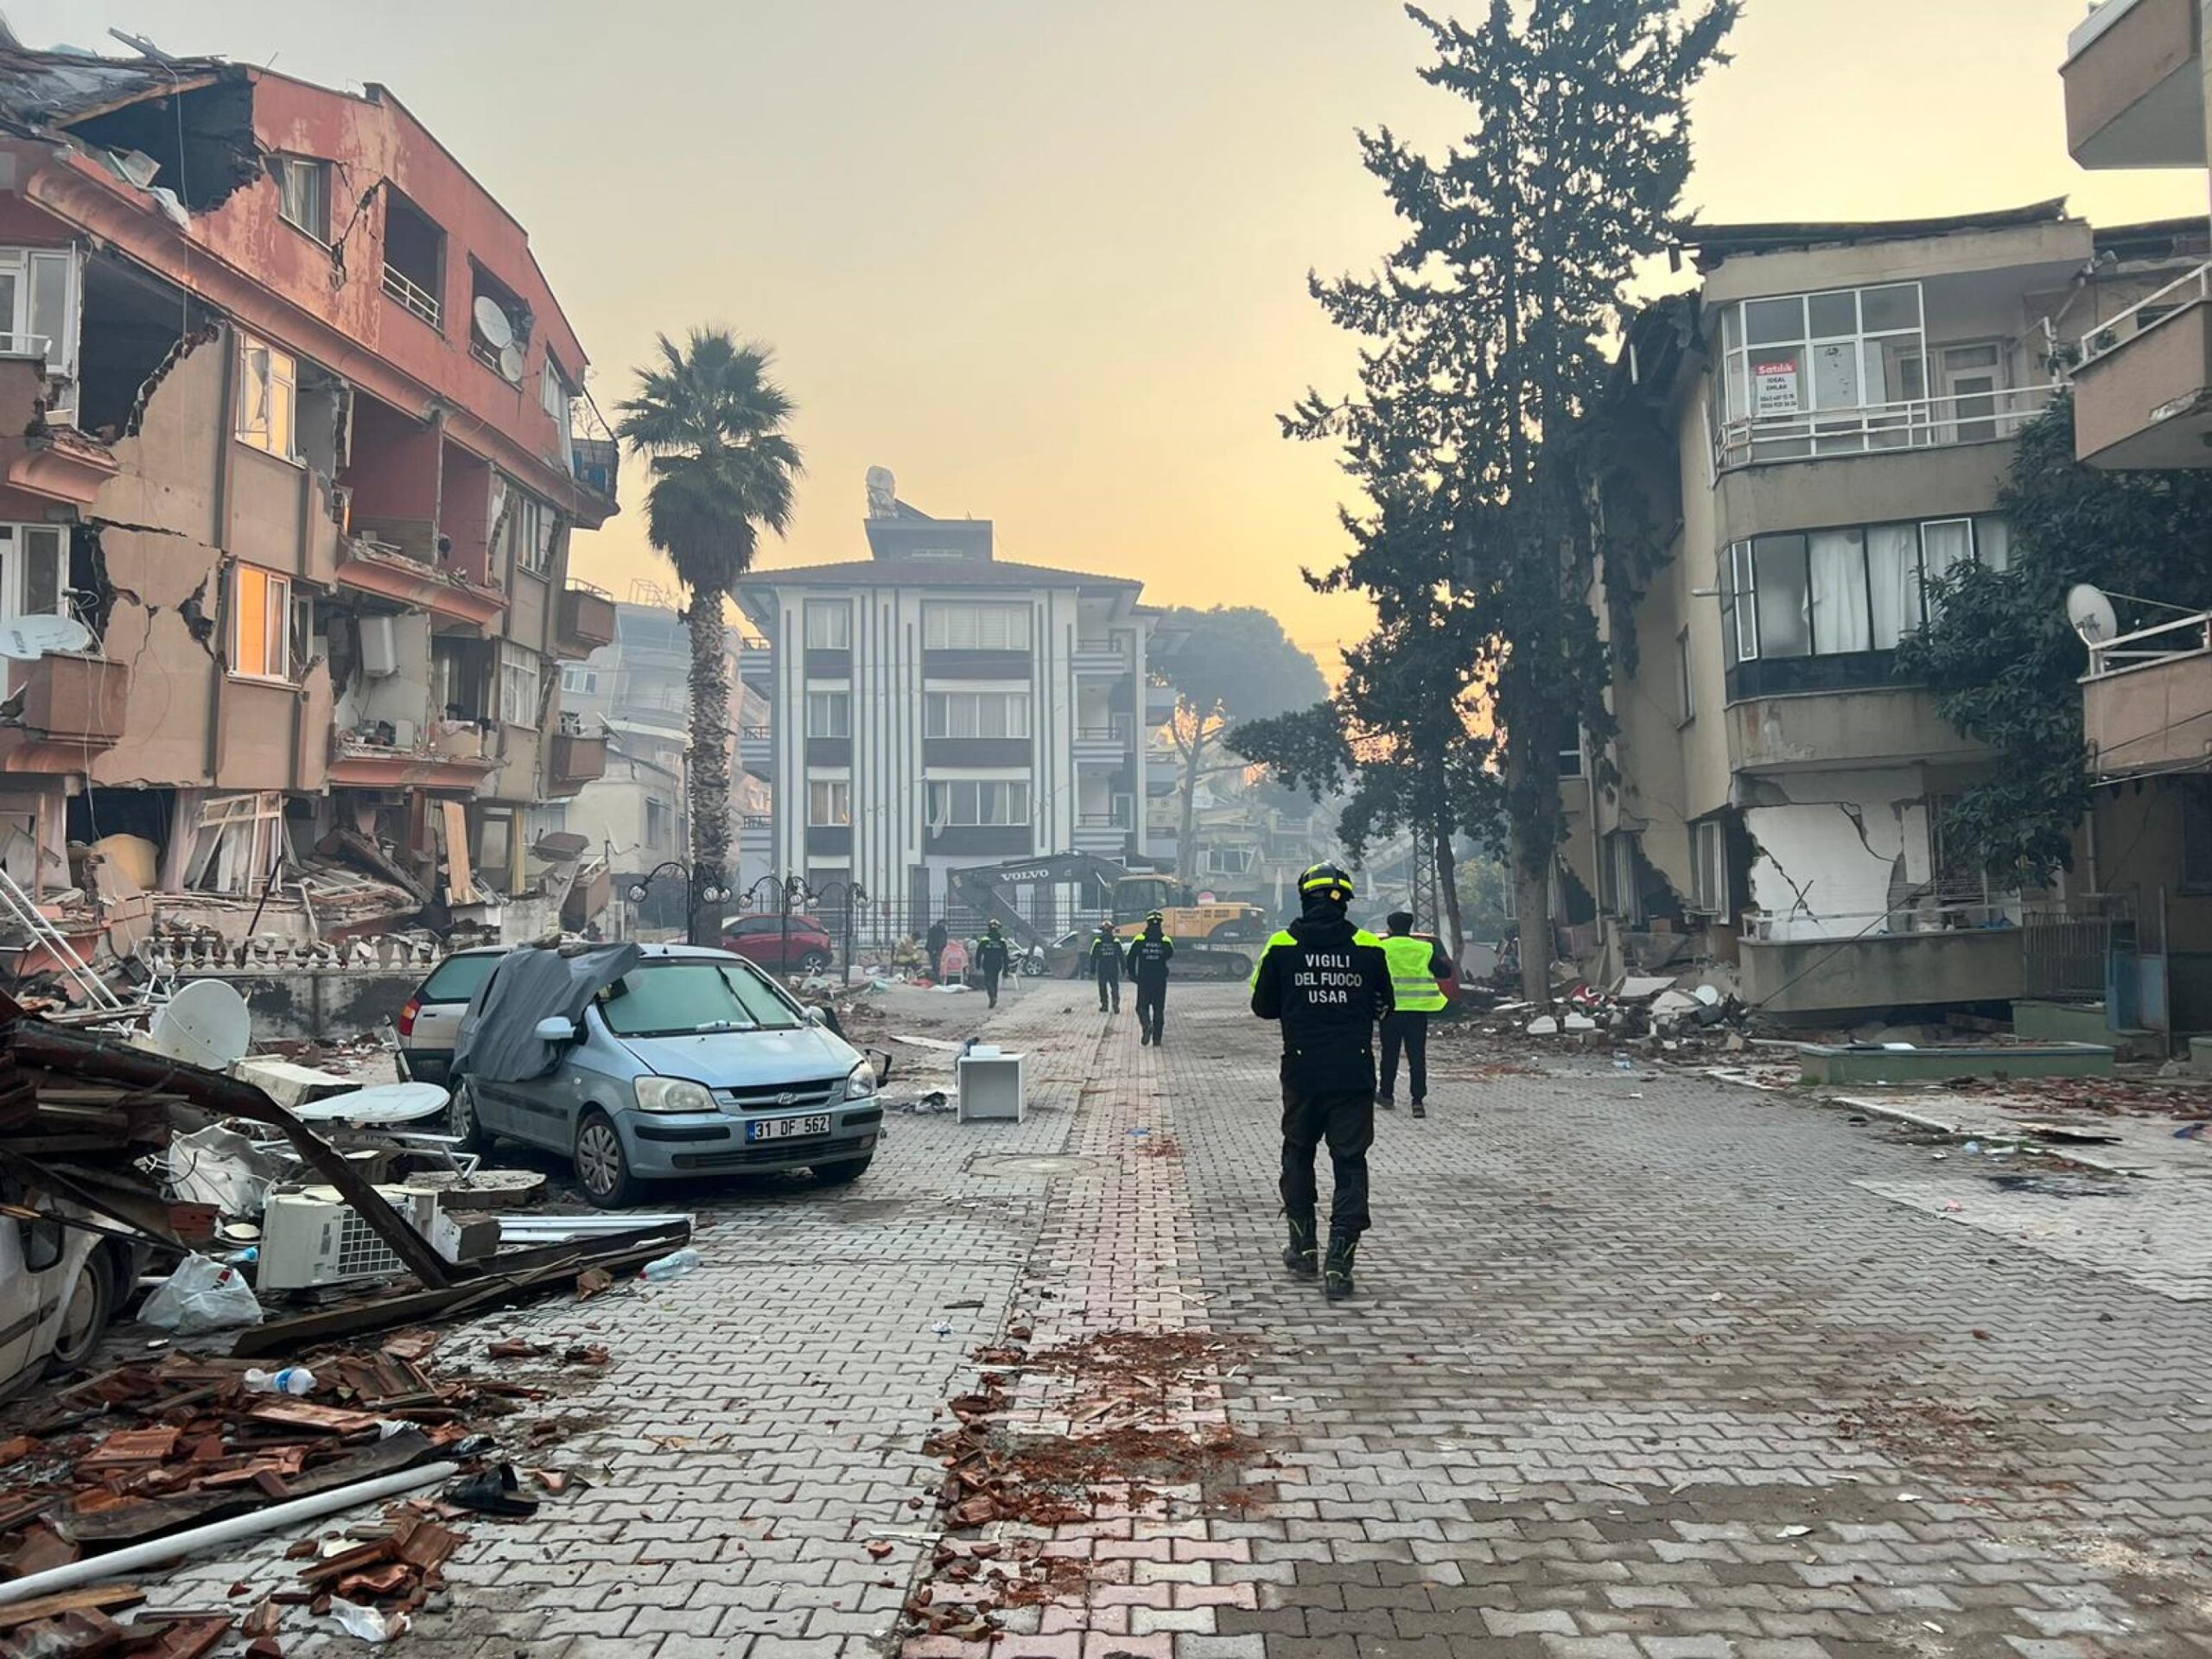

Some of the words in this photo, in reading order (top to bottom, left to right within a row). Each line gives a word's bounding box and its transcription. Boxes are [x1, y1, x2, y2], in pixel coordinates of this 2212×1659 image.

[1001, 868, 1049, 881] VOLVO
[1305, 954, 1350, 968] VIGILI
[1294, 973, 1318, 987] DEL
[1321, 973, 1363, 987] FUOCO
[1308, 990, 1348, 1003] USAR
[755, 1122, 772, 1137] 31
[804, 1116, 826, 1133] 562
